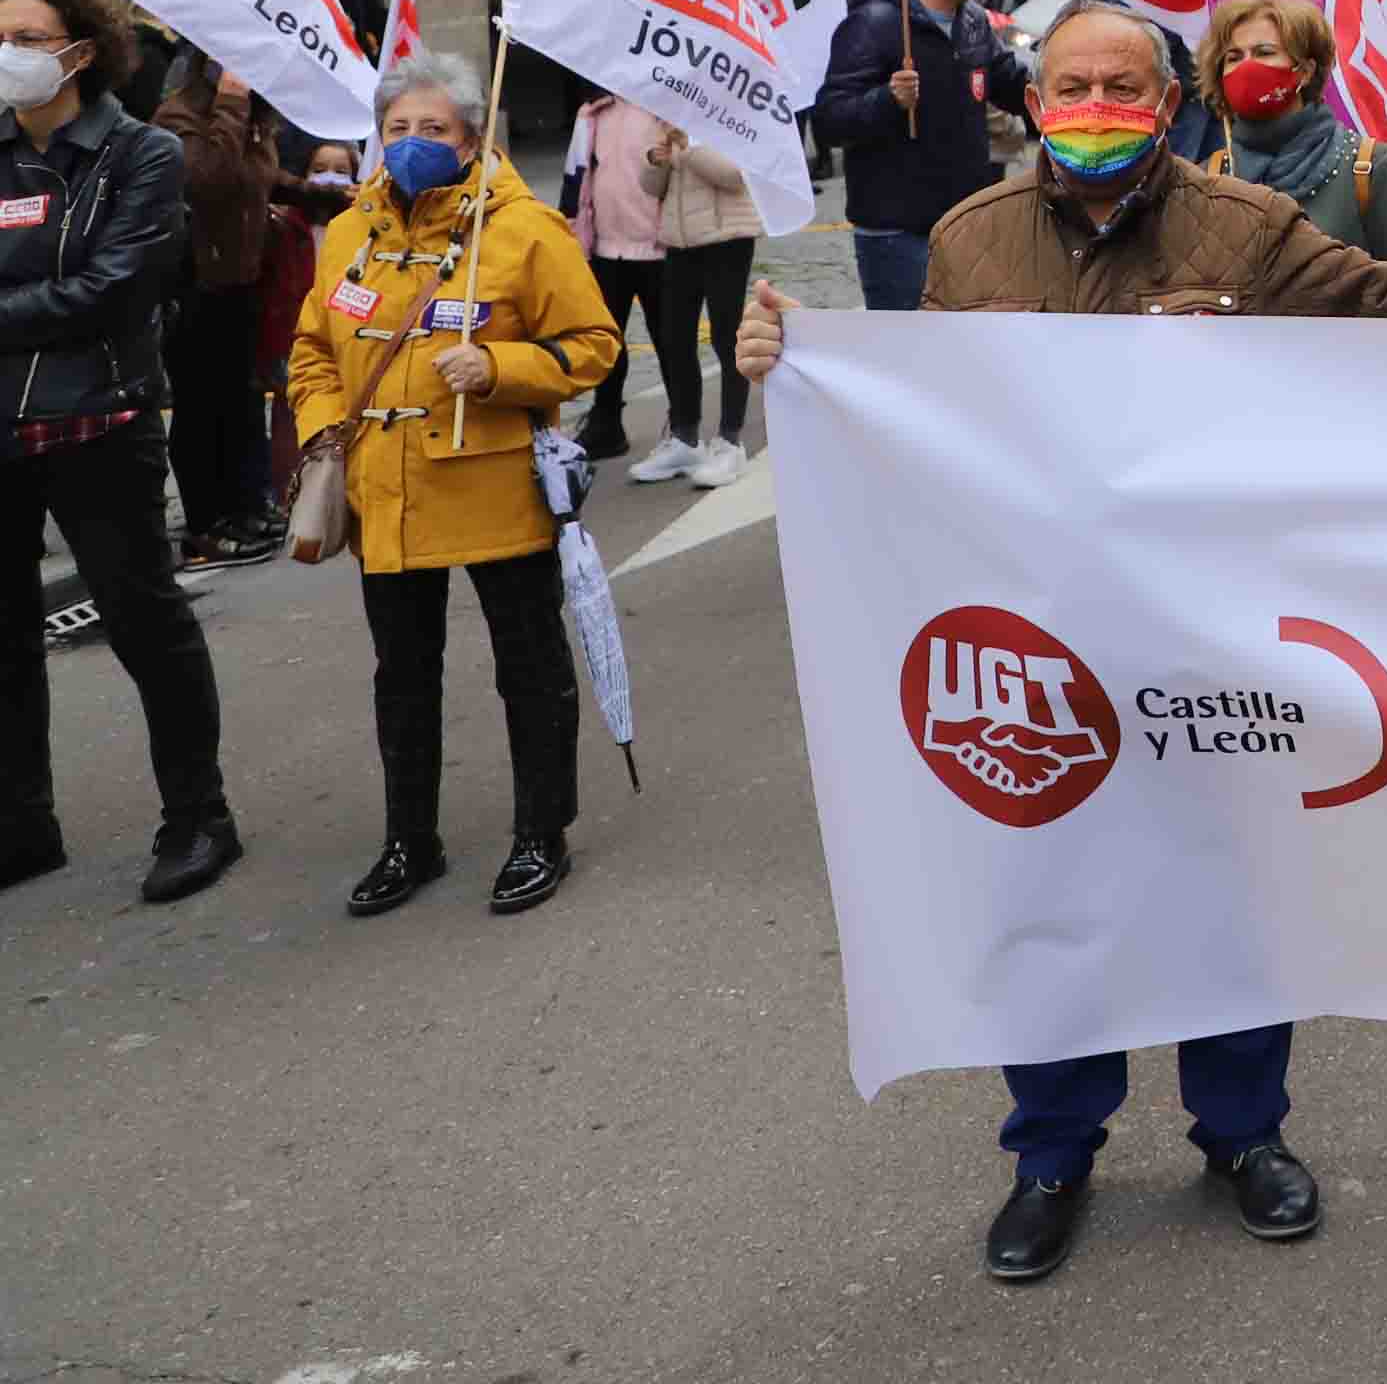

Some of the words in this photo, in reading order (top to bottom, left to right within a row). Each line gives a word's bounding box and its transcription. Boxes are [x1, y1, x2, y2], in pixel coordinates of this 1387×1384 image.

[628, 10, 794, 125] jóvenes
[652, 65, 709, 111] Castilla
[717, 110, 758, 143] León
[927, 636, 1076, 734] UGT
[1136, 686, 1306, 724] Castilla
[1143, 732, 1170, 761] y
[1186, 720, 1298, 755] León
